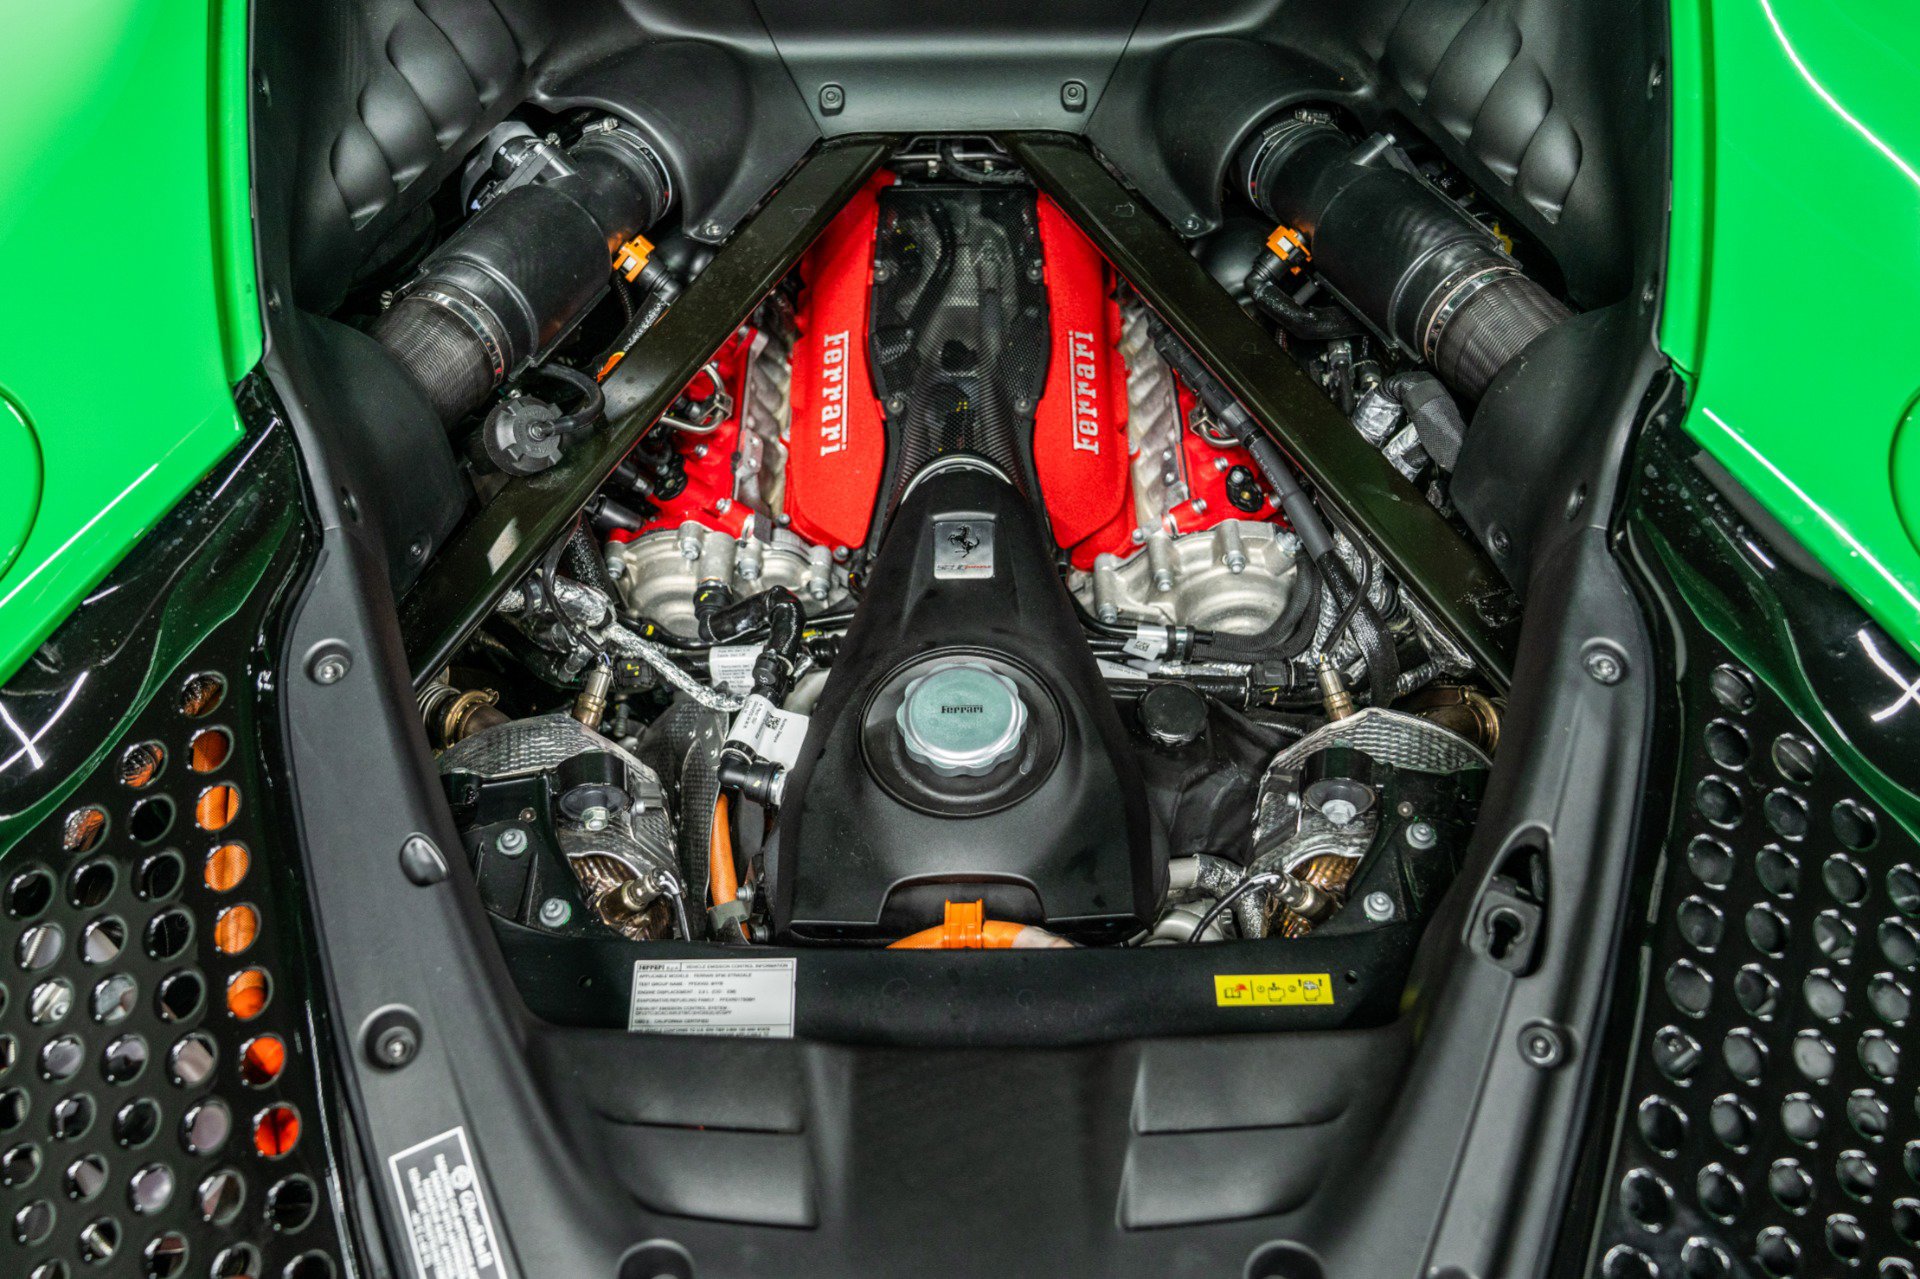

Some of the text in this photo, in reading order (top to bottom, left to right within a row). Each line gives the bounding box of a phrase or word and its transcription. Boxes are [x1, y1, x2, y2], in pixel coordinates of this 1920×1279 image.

[820, 330, 850, 457] Ferrari
[1067, 330, 1100, 456] Ferrari
[940, 704, 984, 714] Ferrari
